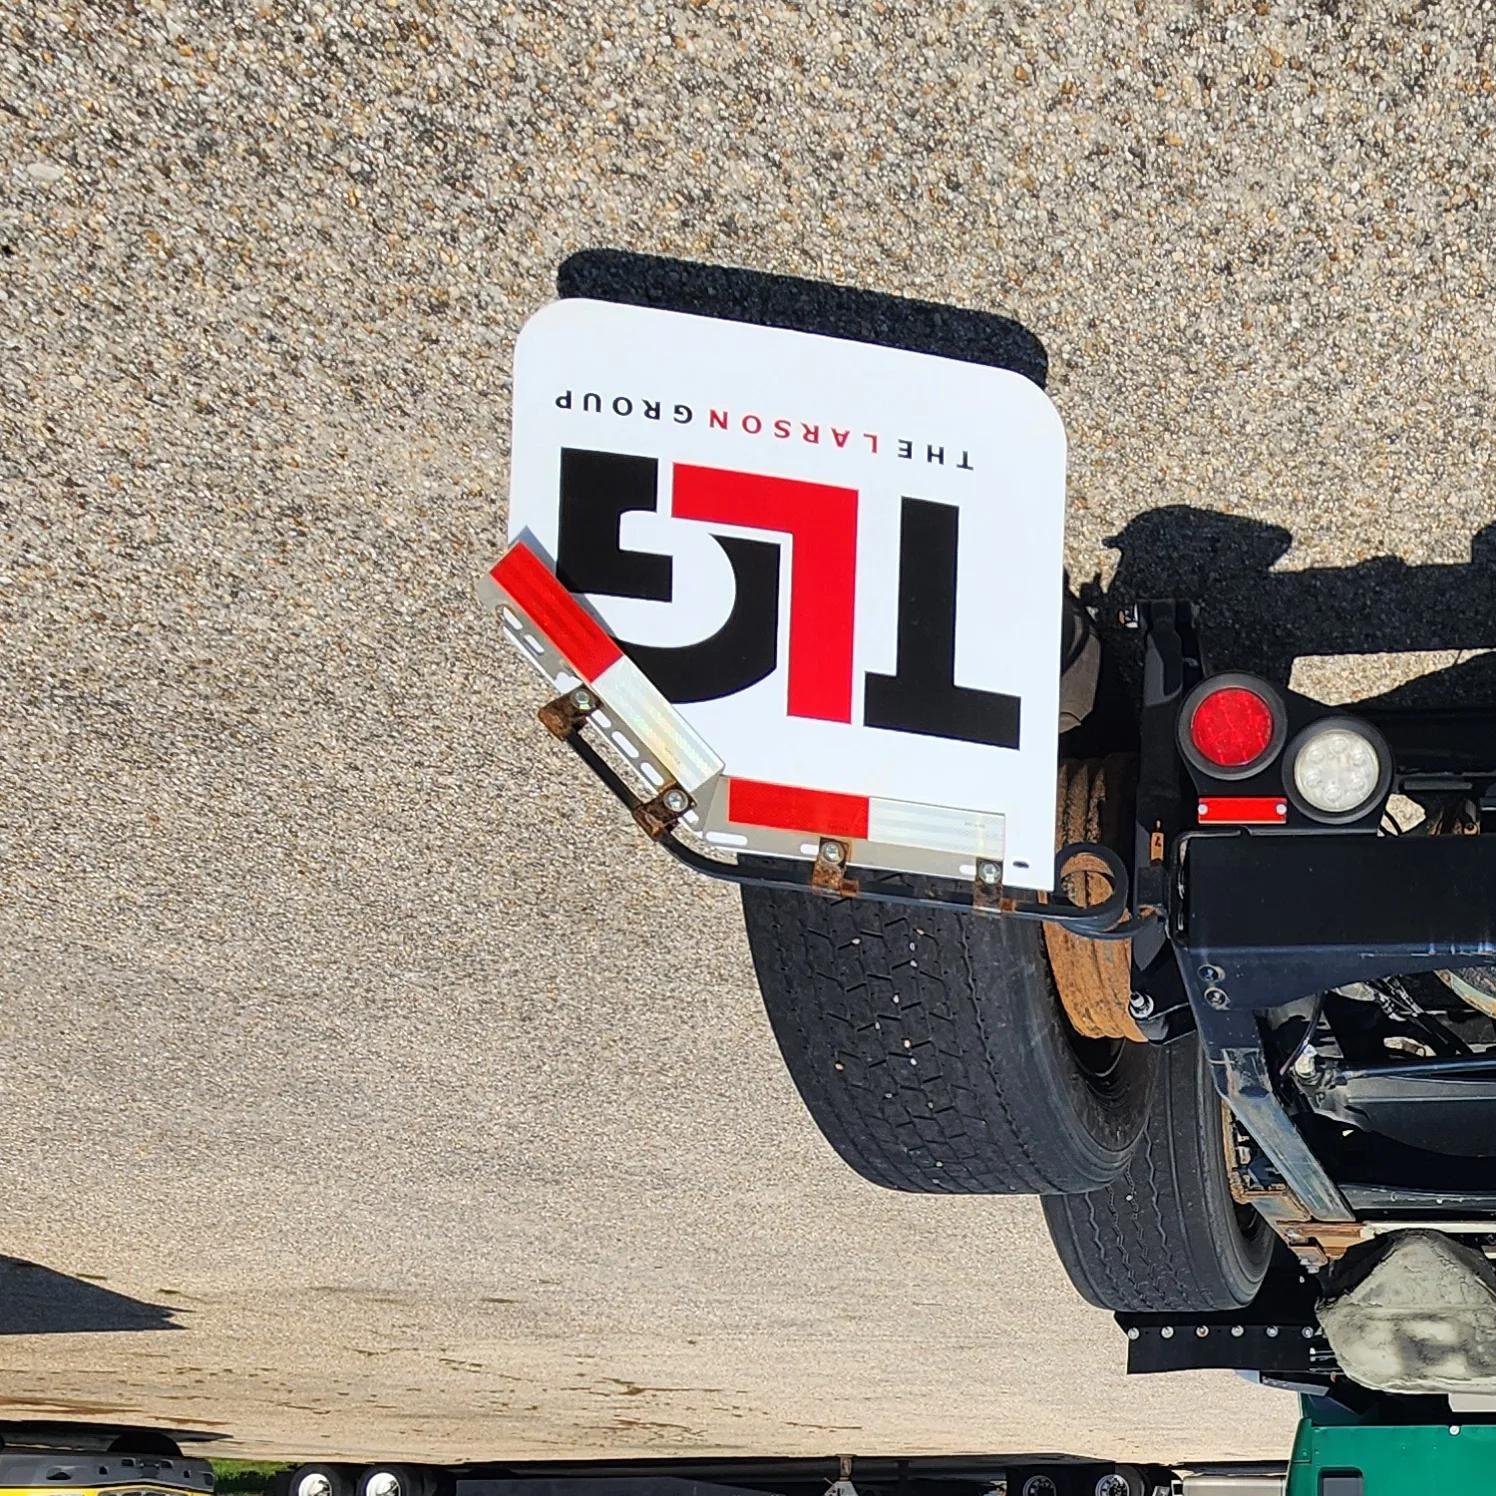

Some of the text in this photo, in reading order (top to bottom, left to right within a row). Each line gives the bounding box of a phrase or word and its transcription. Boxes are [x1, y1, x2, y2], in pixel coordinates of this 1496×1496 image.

[553, 389, 974, 472] THE LARSON GROUP
[556, 447, 1021, 752] TLG
